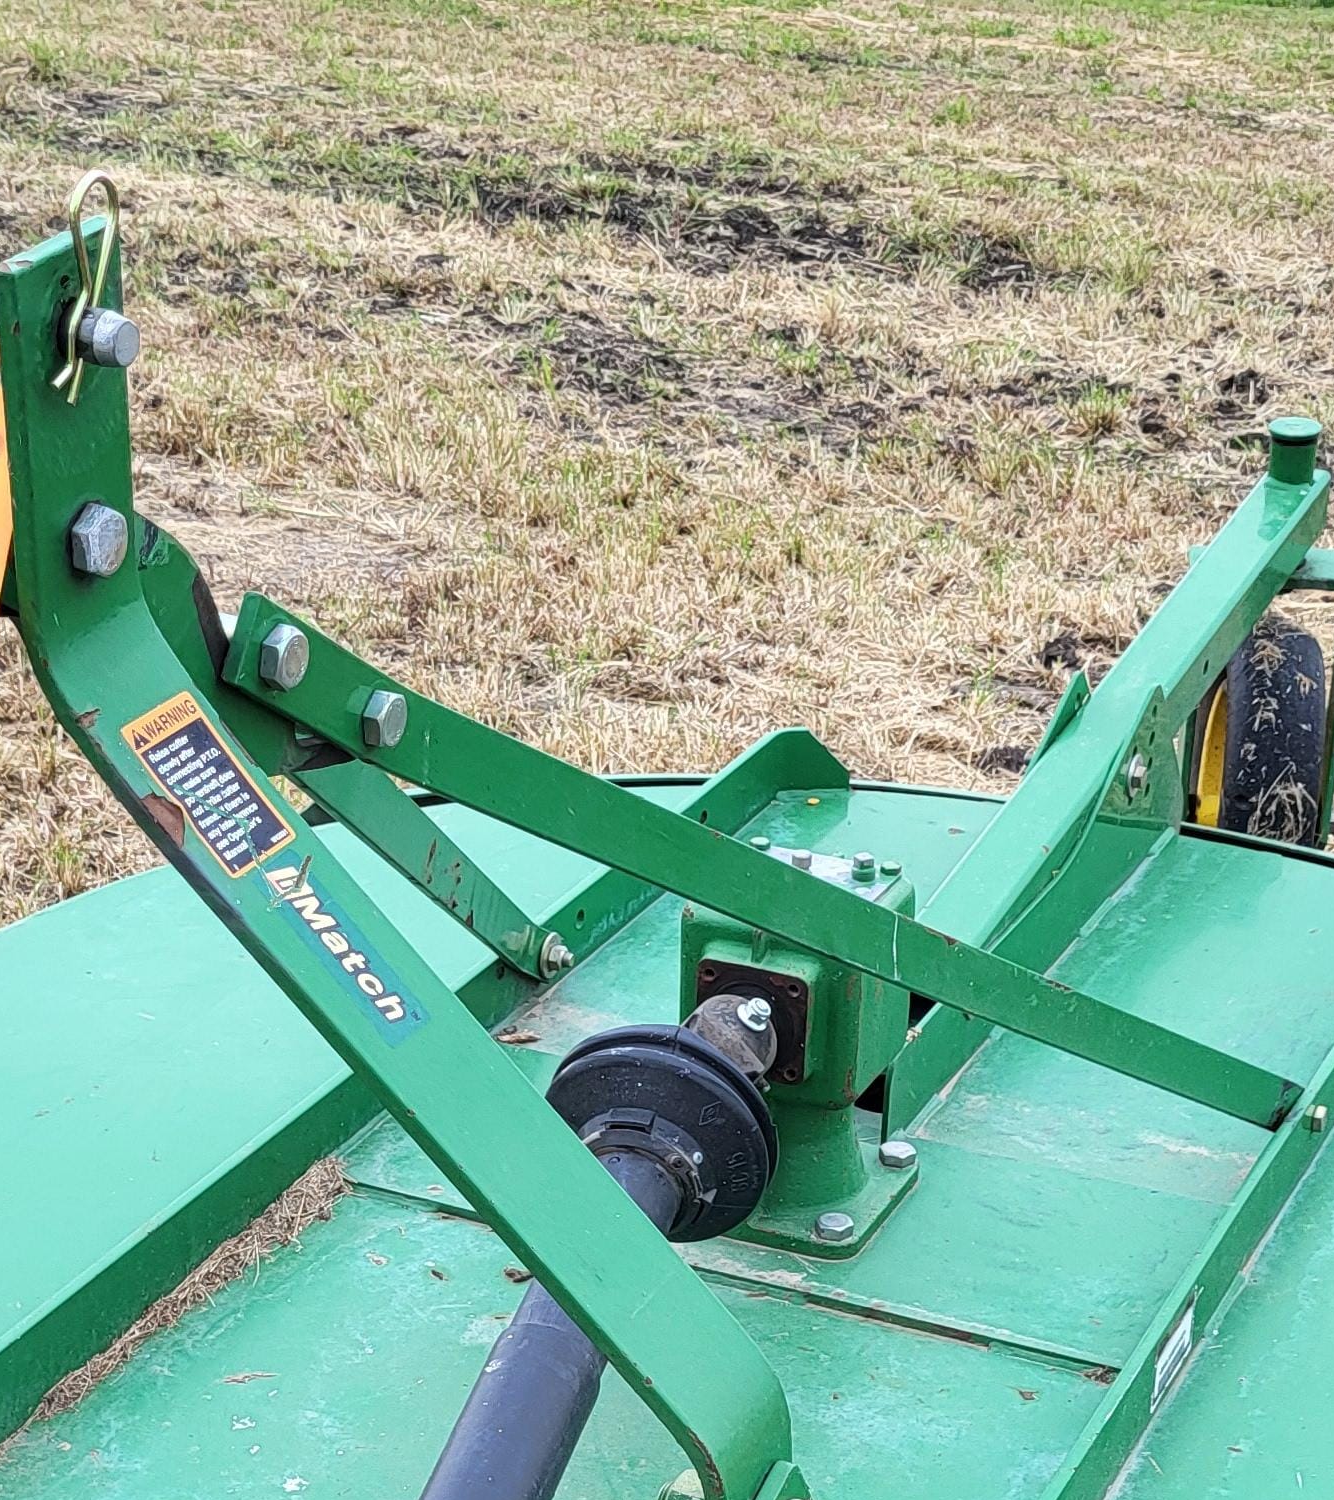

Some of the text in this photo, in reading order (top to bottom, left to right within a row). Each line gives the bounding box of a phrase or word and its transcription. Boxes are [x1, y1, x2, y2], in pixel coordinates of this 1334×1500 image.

[143, 699, 195, 737] WARNING
[148, 735, 188, 763] Raise cutter
[157, 746, 195, 774] slowly after
[166, 747, 221, 785] connecting P.T.O.
[199, 766, 216, 780] sure
[184, 778, 220, 807] poershaft
[191, 804, 204, 817] not
